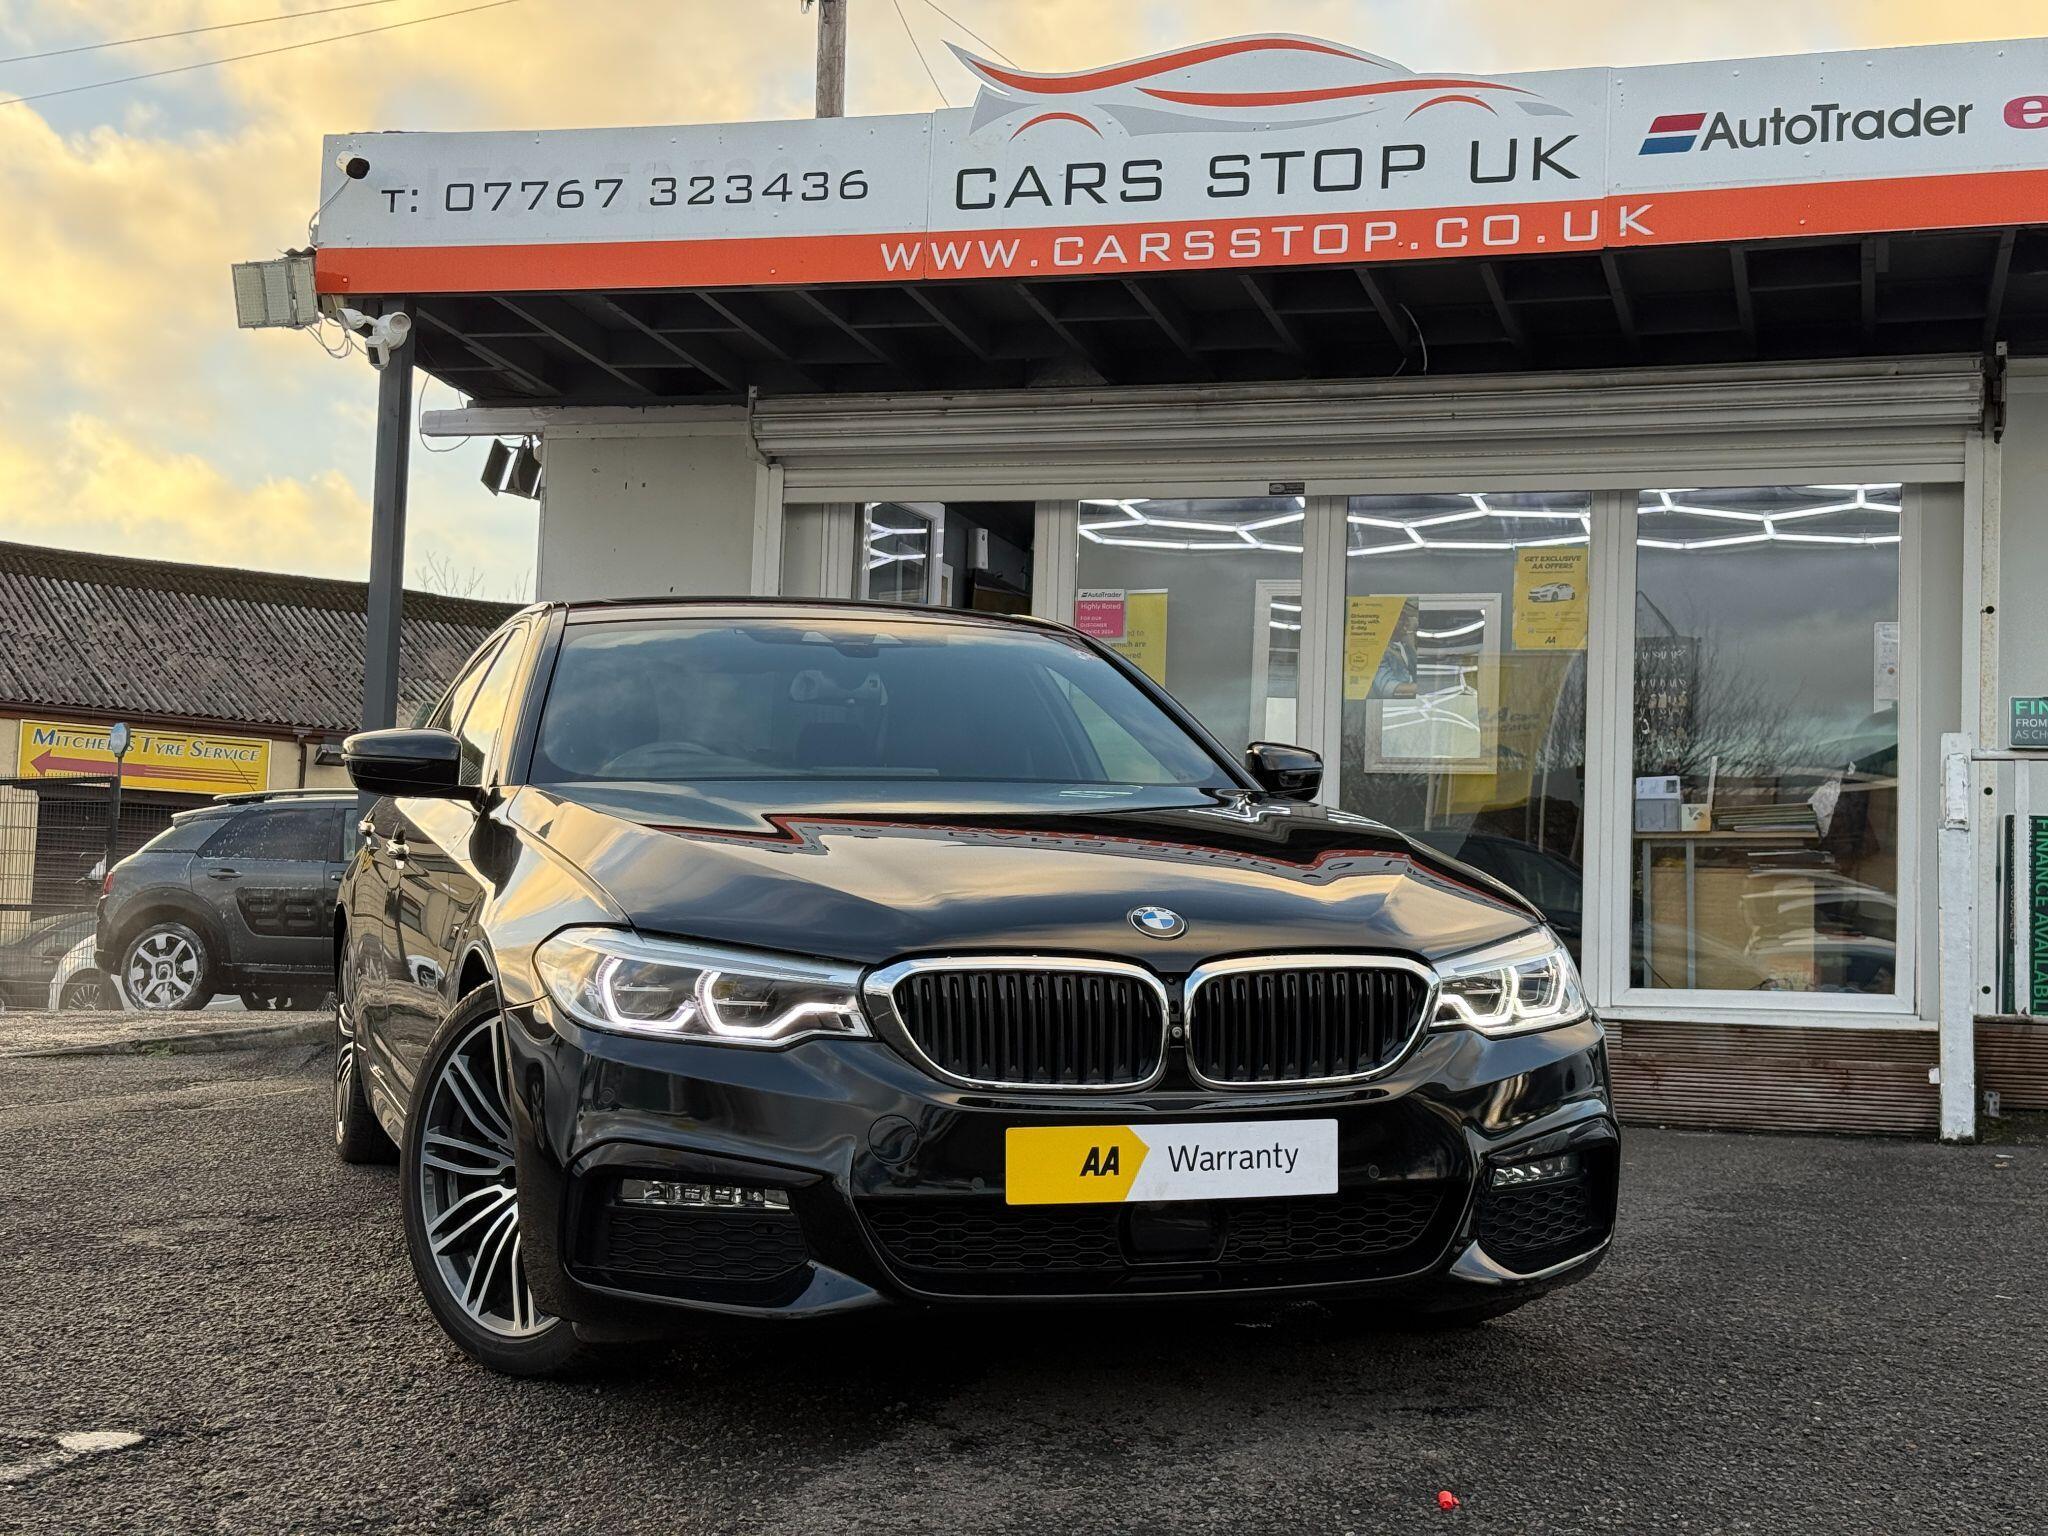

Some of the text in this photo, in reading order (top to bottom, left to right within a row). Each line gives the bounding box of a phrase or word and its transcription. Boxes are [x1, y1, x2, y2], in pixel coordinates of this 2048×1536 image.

[1700, 98, 1974, 152] AutoTrader
[956, 134, 1581, 211] CARS STOP UK
[381, 169, 870, 213] T: 07767 323436
[880, 203, 1656, 273] WWW.CARSSTOP.CO.UK
[1081, 603, 1100, 611] Highly
[1544, 636, 1556, 645] AA
[2014, 729, 2048, 740] AS CH
[2015, 718, 2048, 728] FROM
[190, 740, 260, 762] SERVICE
[1080, 1142, 1299, 1177] AA Warranty
